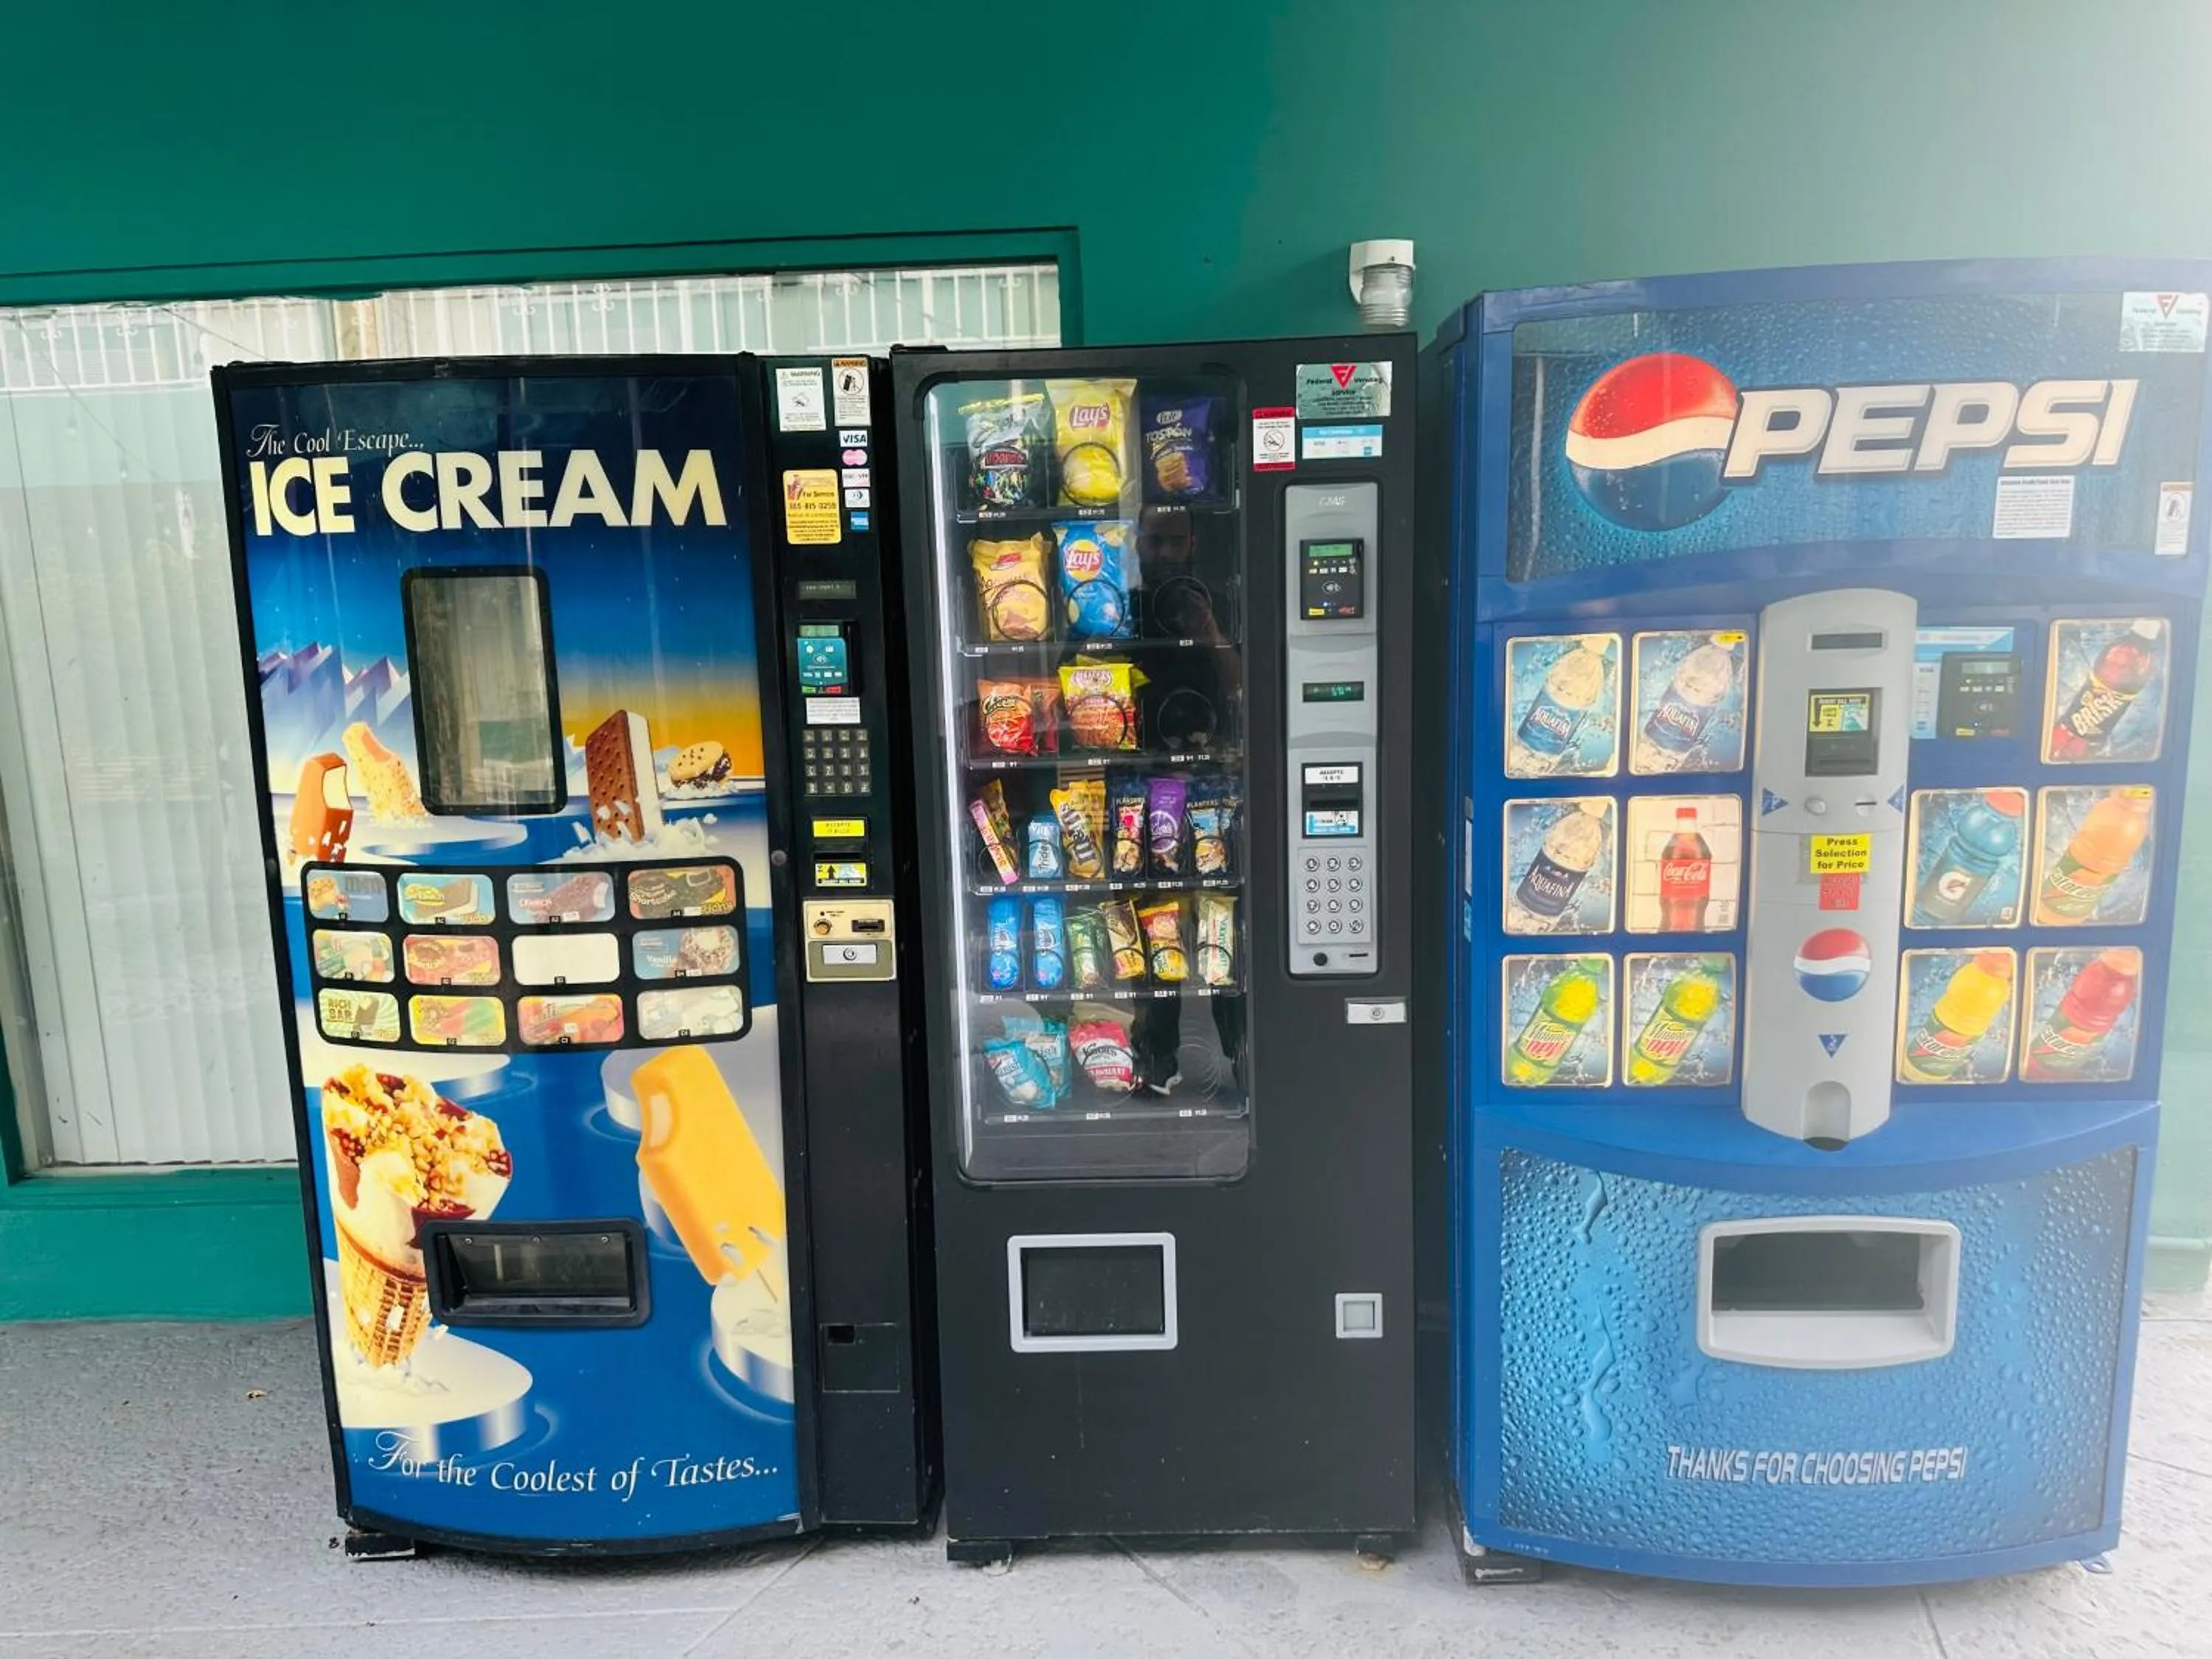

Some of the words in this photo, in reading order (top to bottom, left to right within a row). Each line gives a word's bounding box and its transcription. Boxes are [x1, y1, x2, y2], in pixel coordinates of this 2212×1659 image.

[246, 424, 285, 458] The
[294, 427, 330, 454] Cool
[843, 434, 866, 444] VISA
[1723, 378, 2139, 478] PEPSI
[249, 456, 355, 536] ICE
[381, 448, 728, 532] CREAM
[1066, 548, 1102, 571] Lay's
[1815, 849, 1867, 858] Selection
[1826, 838, 1858, 846] Press
[1817, 860, 1834, 869] for
[1837, 860, 1864, 869] Price
[1528, 864, 1574, 897] AQUAFINA
[1938, 872, 1971, 900] G
[369, 1430, 429, 1479] For
[437, 1453, 478, 1486] the
[490, 1460, 596, 1493] Coolest
[611, 1456, 645, 1503] of
[1667, 1445, 1750, 1483] THANKS
[1752, 1451, 1799, 1484] FOR
[1801, 1450, 1907, 1485] CHOOSING
[1910, 1446, 1969, 1482] PEPSI
